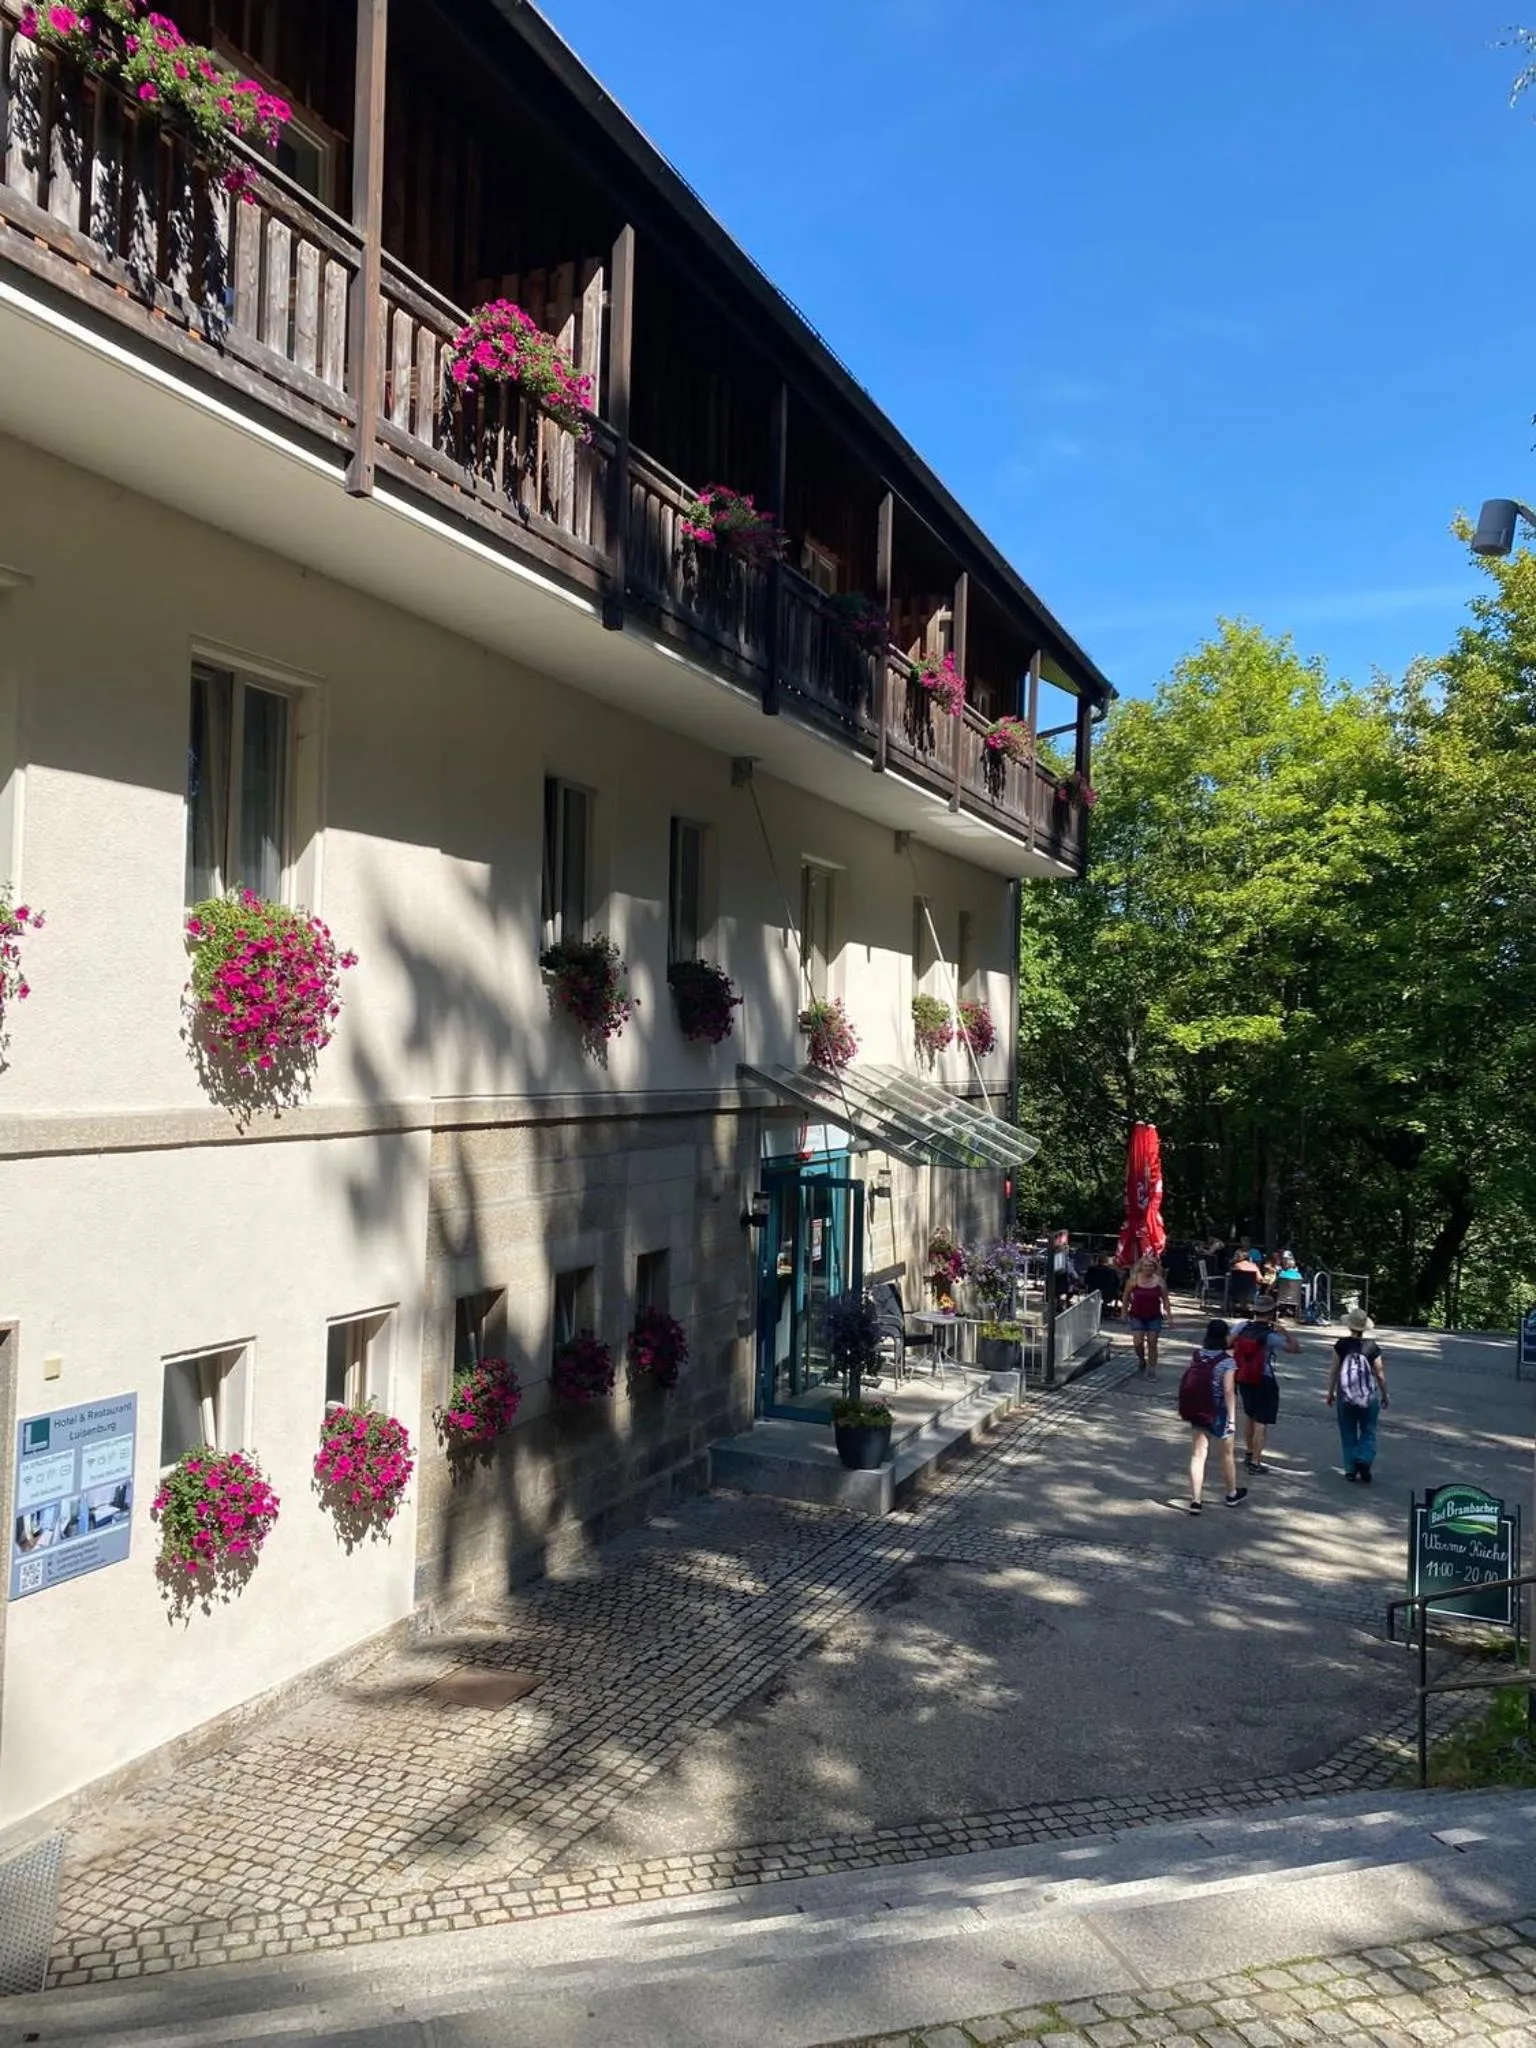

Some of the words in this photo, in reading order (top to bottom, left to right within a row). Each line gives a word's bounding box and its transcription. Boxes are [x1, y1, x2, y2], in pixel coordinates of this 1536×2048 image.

[54, 1415, 77, 1429] Hotel
[79, 1413, 86, 1422] &
[87, 1402, 132, 1420] Restaurant
[68, 1422, 117, 1441] Luisenburg
[1431, 1509, 1445, 1523] Bad
[1446, 1500, 1499, 1517] Brambacher
[1469, 1540, 1508, 1561] Küche
